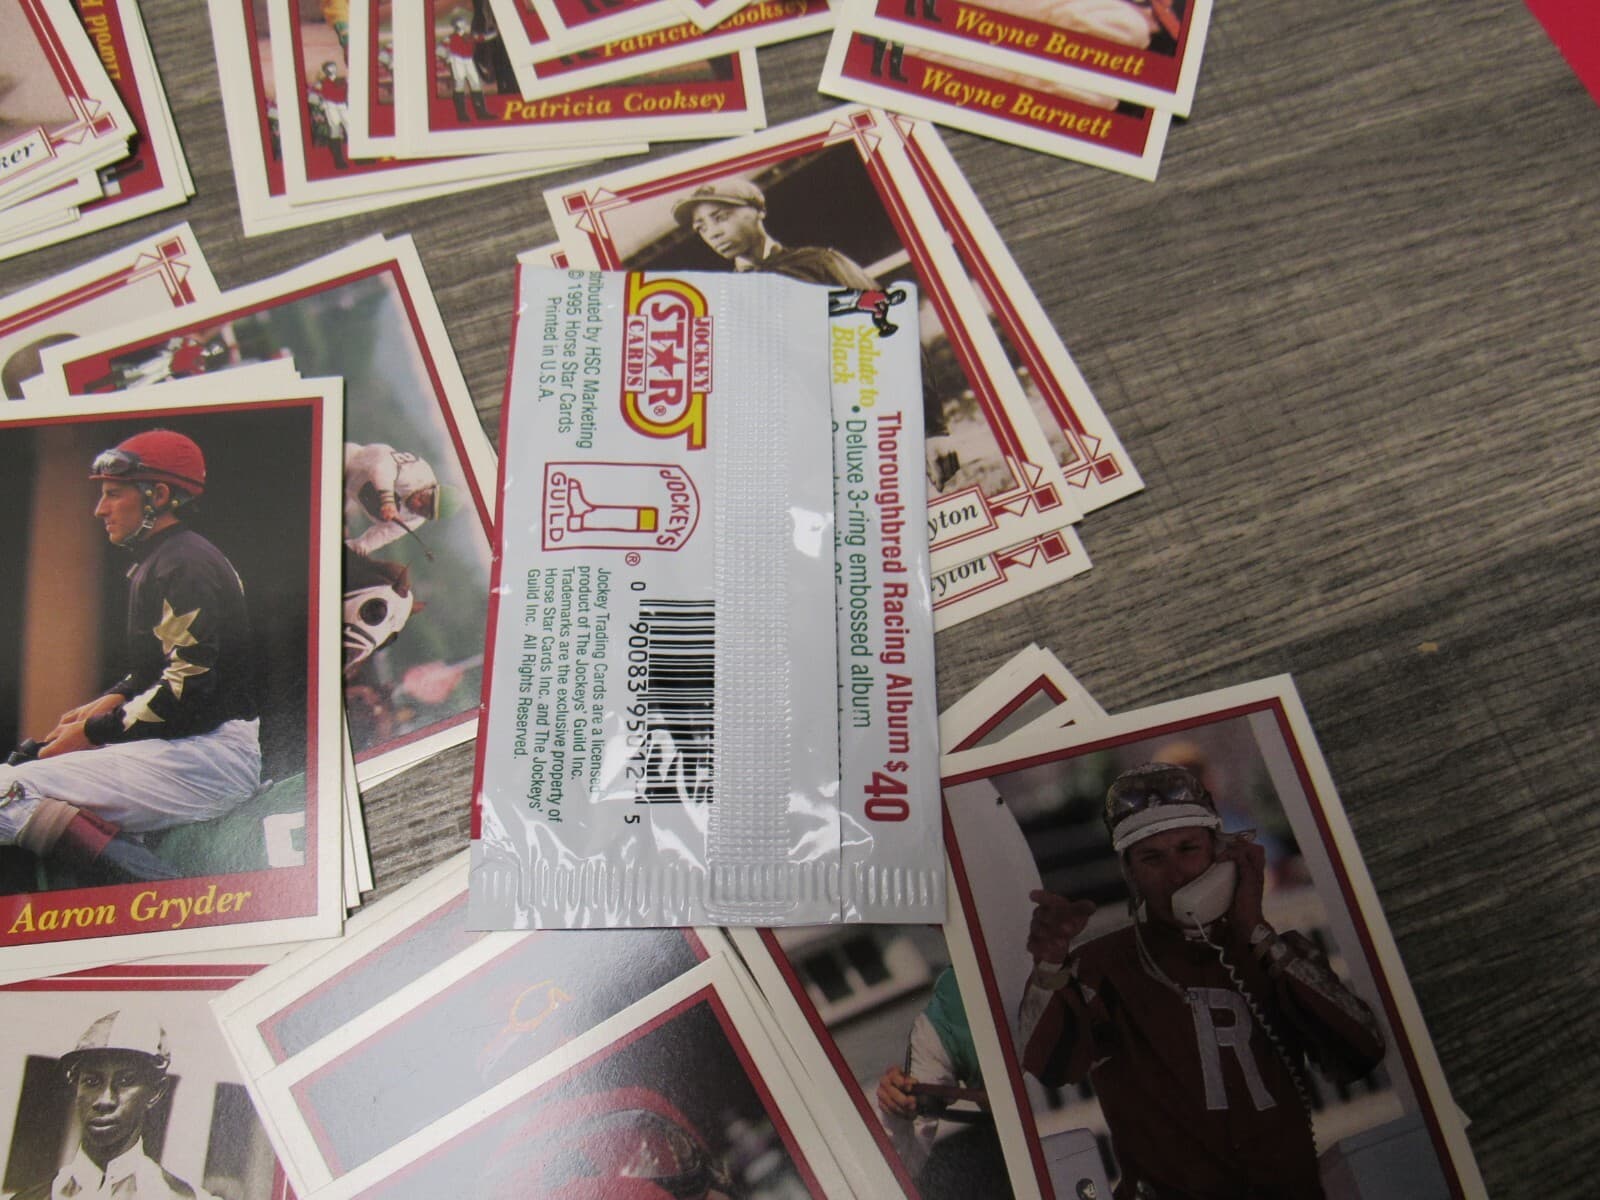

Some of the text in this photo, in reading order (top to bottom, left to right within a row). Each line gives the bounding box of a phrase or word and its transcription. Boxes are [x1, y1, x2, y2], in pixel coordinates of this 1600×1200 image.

[954, 7, 1145, 76] Wayne Barnett
[502, 90, 726, 121] Patricia Cooksey
[921, 67, 1113, 139] Wayne Barnett
[566, 284, 583, 317] 1995
[582, 326, 601, 342] by
[538, 296, 562, 402] Printed in U.S.A.
[562, 320, 581, 358] Horse
[583, 346, 601, 375] HSC
[627, 319, 646, 388] CARDS
[693, 319, 711, 391] JOCKEY
[832, 325, 856, 384] Black
[857, 324, 881, 408] Salute to
[561, 361, 579, 389] Star
[557, 393, 577, 434] Cards
[576, 379, 599, 450] Marketing
[549, 472, 567, 544] GUILD
[656, 469, 691, 546] JOCKEYS
[874, 410, 908, 573] Thoroughbred
[594, 567, 612, 609] Jockey
[844, 419, 875, 728] Deluxe 3-ring embossed album
[592, 613, 611, 659] Trading
[628, 622, 649, 693] 90083
[880, 582, 911, 664] Racing
[514, 569, 541, 760] Guild Inc. All Rights Reserved.
[527, 567, 558, 812] Horse Star Cards Inc. and The Jockeys'
[547, 566, 576, 823] Trademarks are the exclusive property of
[571, 566, 592, 780] product of The Jockeys' Guild Inc.
[592, 663, 608, 700] Cards
[591, 703, 605, 724] are
[591, 728, 603, 736] a
[886, 673, 913, 754] Album
[8, 885, 252, 934] Aaron Gryder
[1185, 986, 1278, 1112] R
